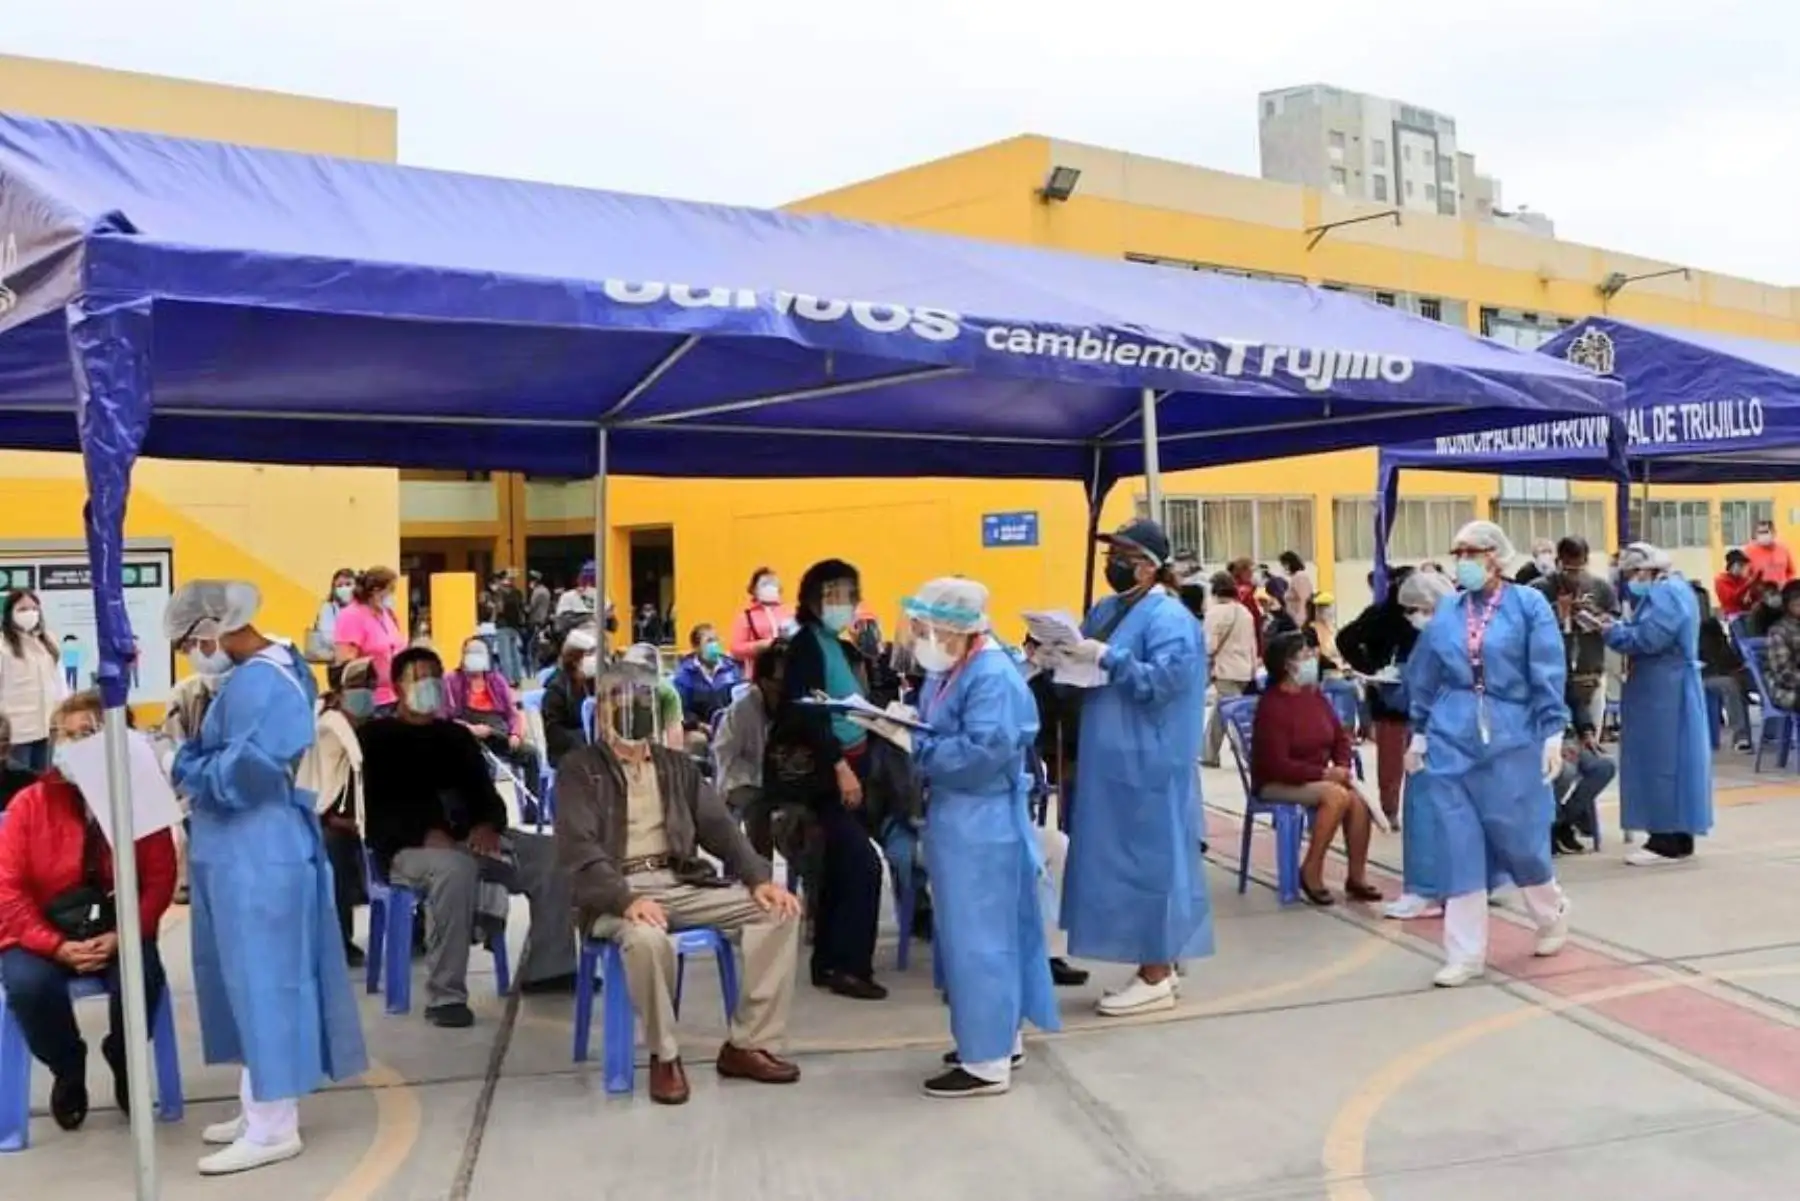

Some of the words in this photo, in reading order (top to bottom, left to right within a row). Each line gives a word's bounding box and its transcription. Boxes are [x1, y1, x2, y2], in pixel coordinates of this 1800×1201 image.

[985, 325, 1215, 372] cambiemos
[1552, 407, 1650, 449] PROVINAL
[1653, 405, 1677, 442] DE
[1680, 397, 1764, 441] TRUJILLO
